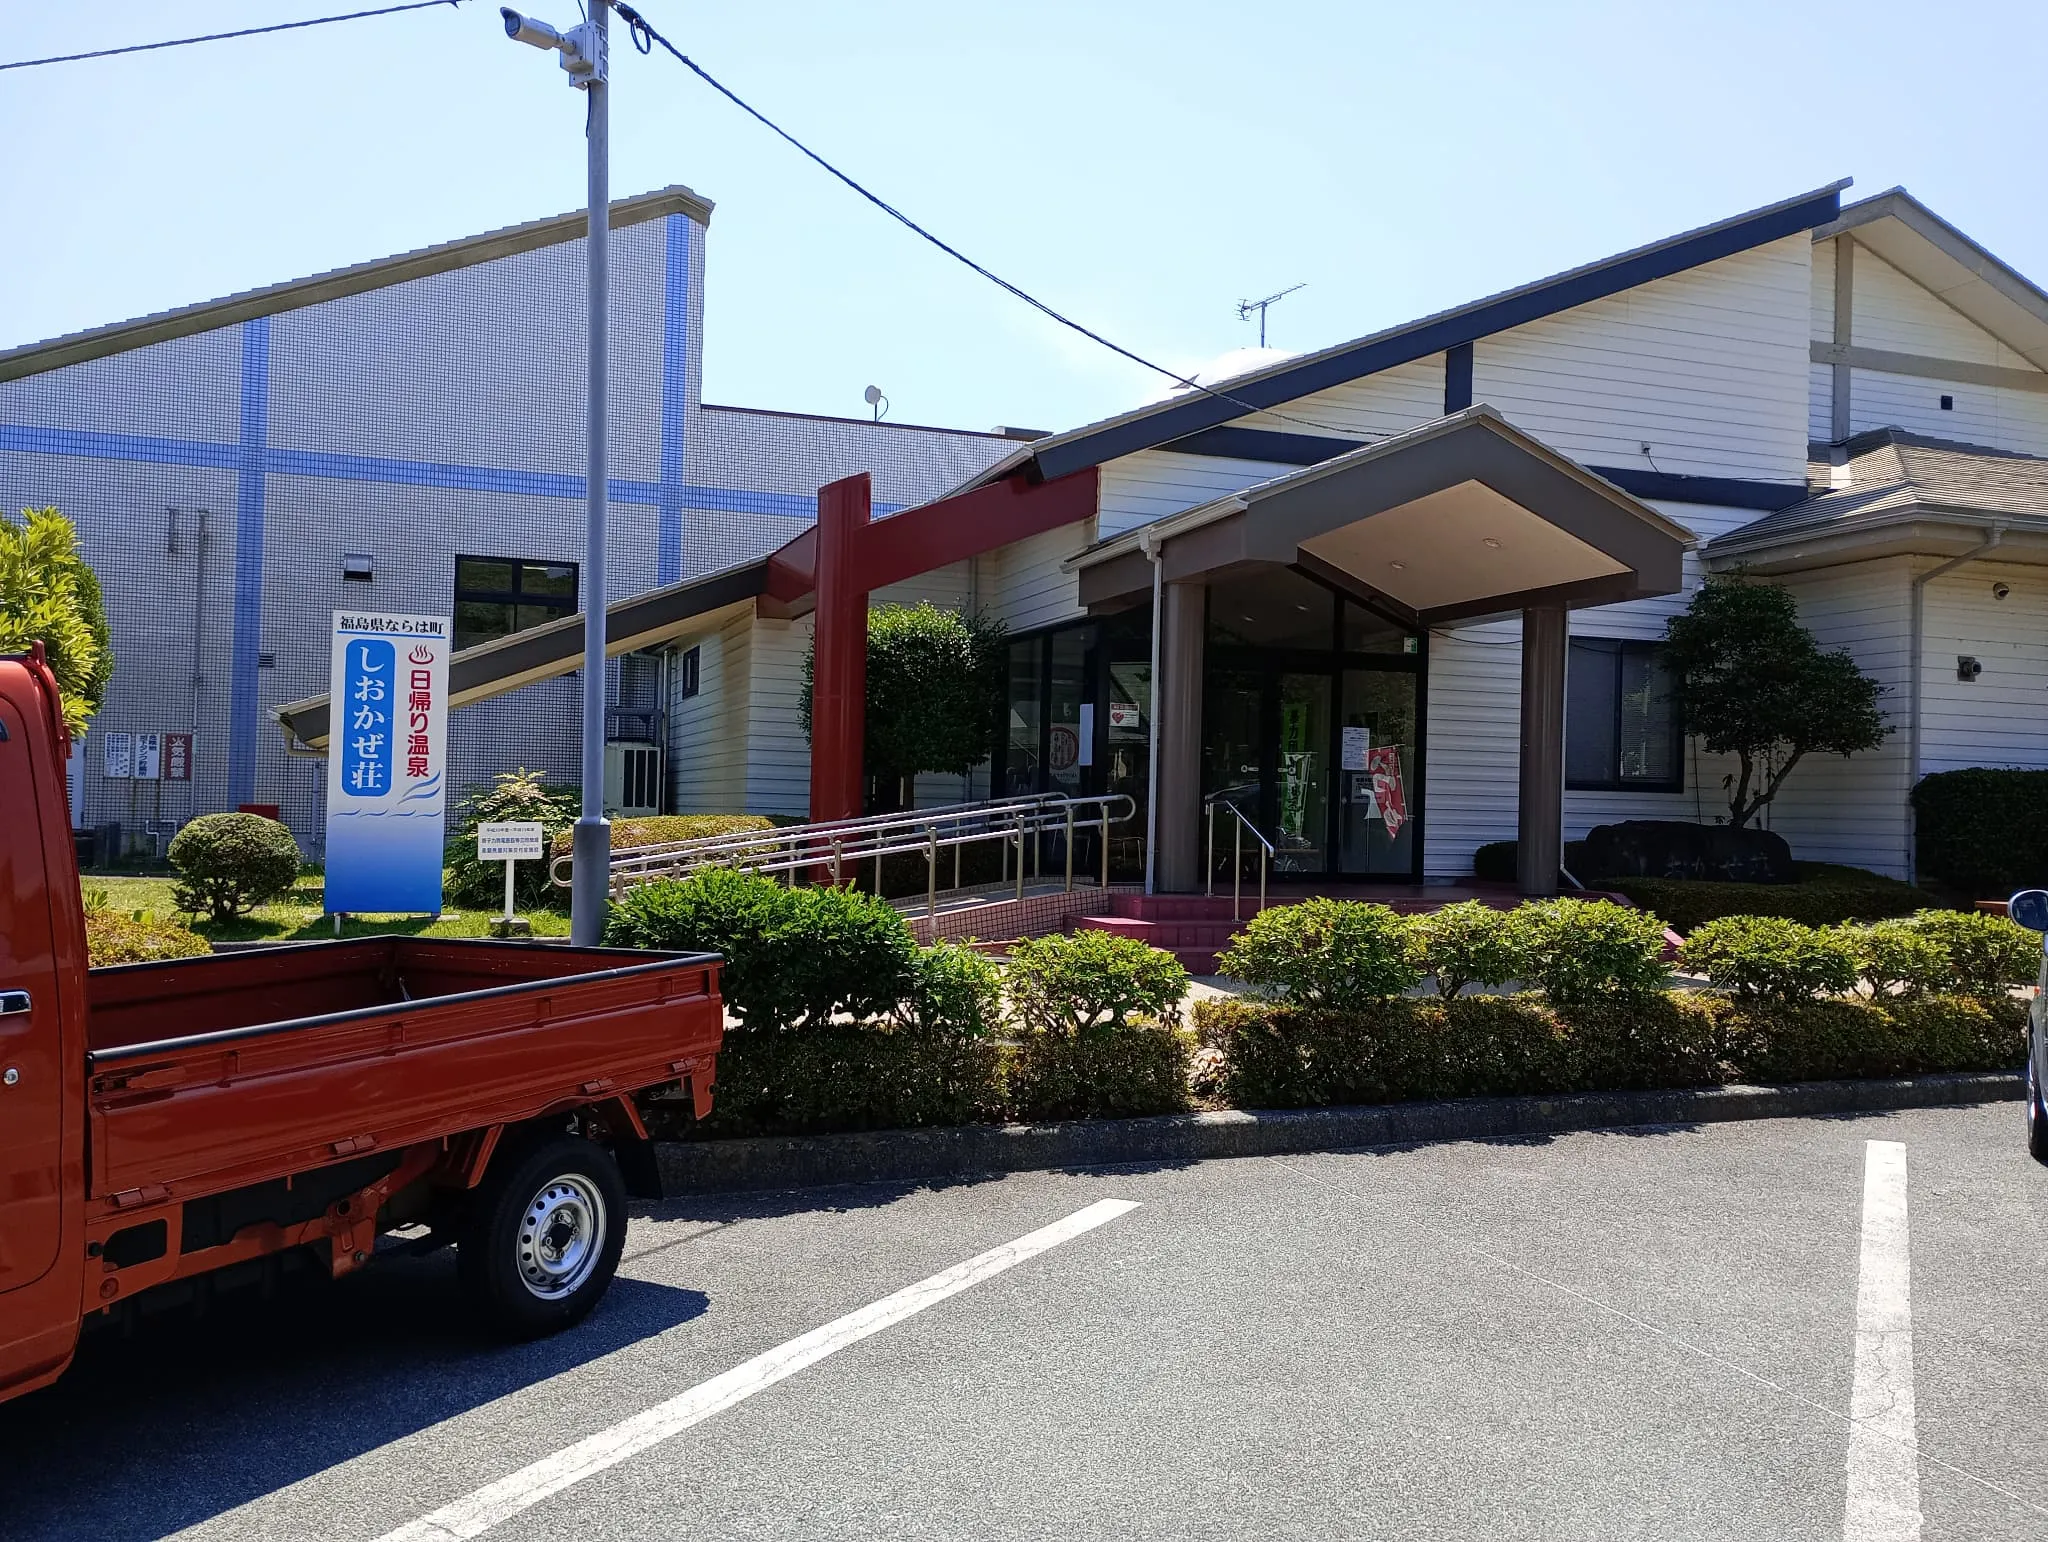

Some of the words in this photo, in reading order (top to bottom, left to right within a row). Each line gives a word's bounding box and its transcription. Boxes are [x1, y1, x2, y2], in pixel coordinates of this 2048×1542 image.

[340, 615, 445, 636] 福島県ならは町
[350, 646, 385, 790] しおかぜ荘
[407, 669, 431, 778] 日帰り温泉
[168, 736, 186, 778] 火気厳禁
